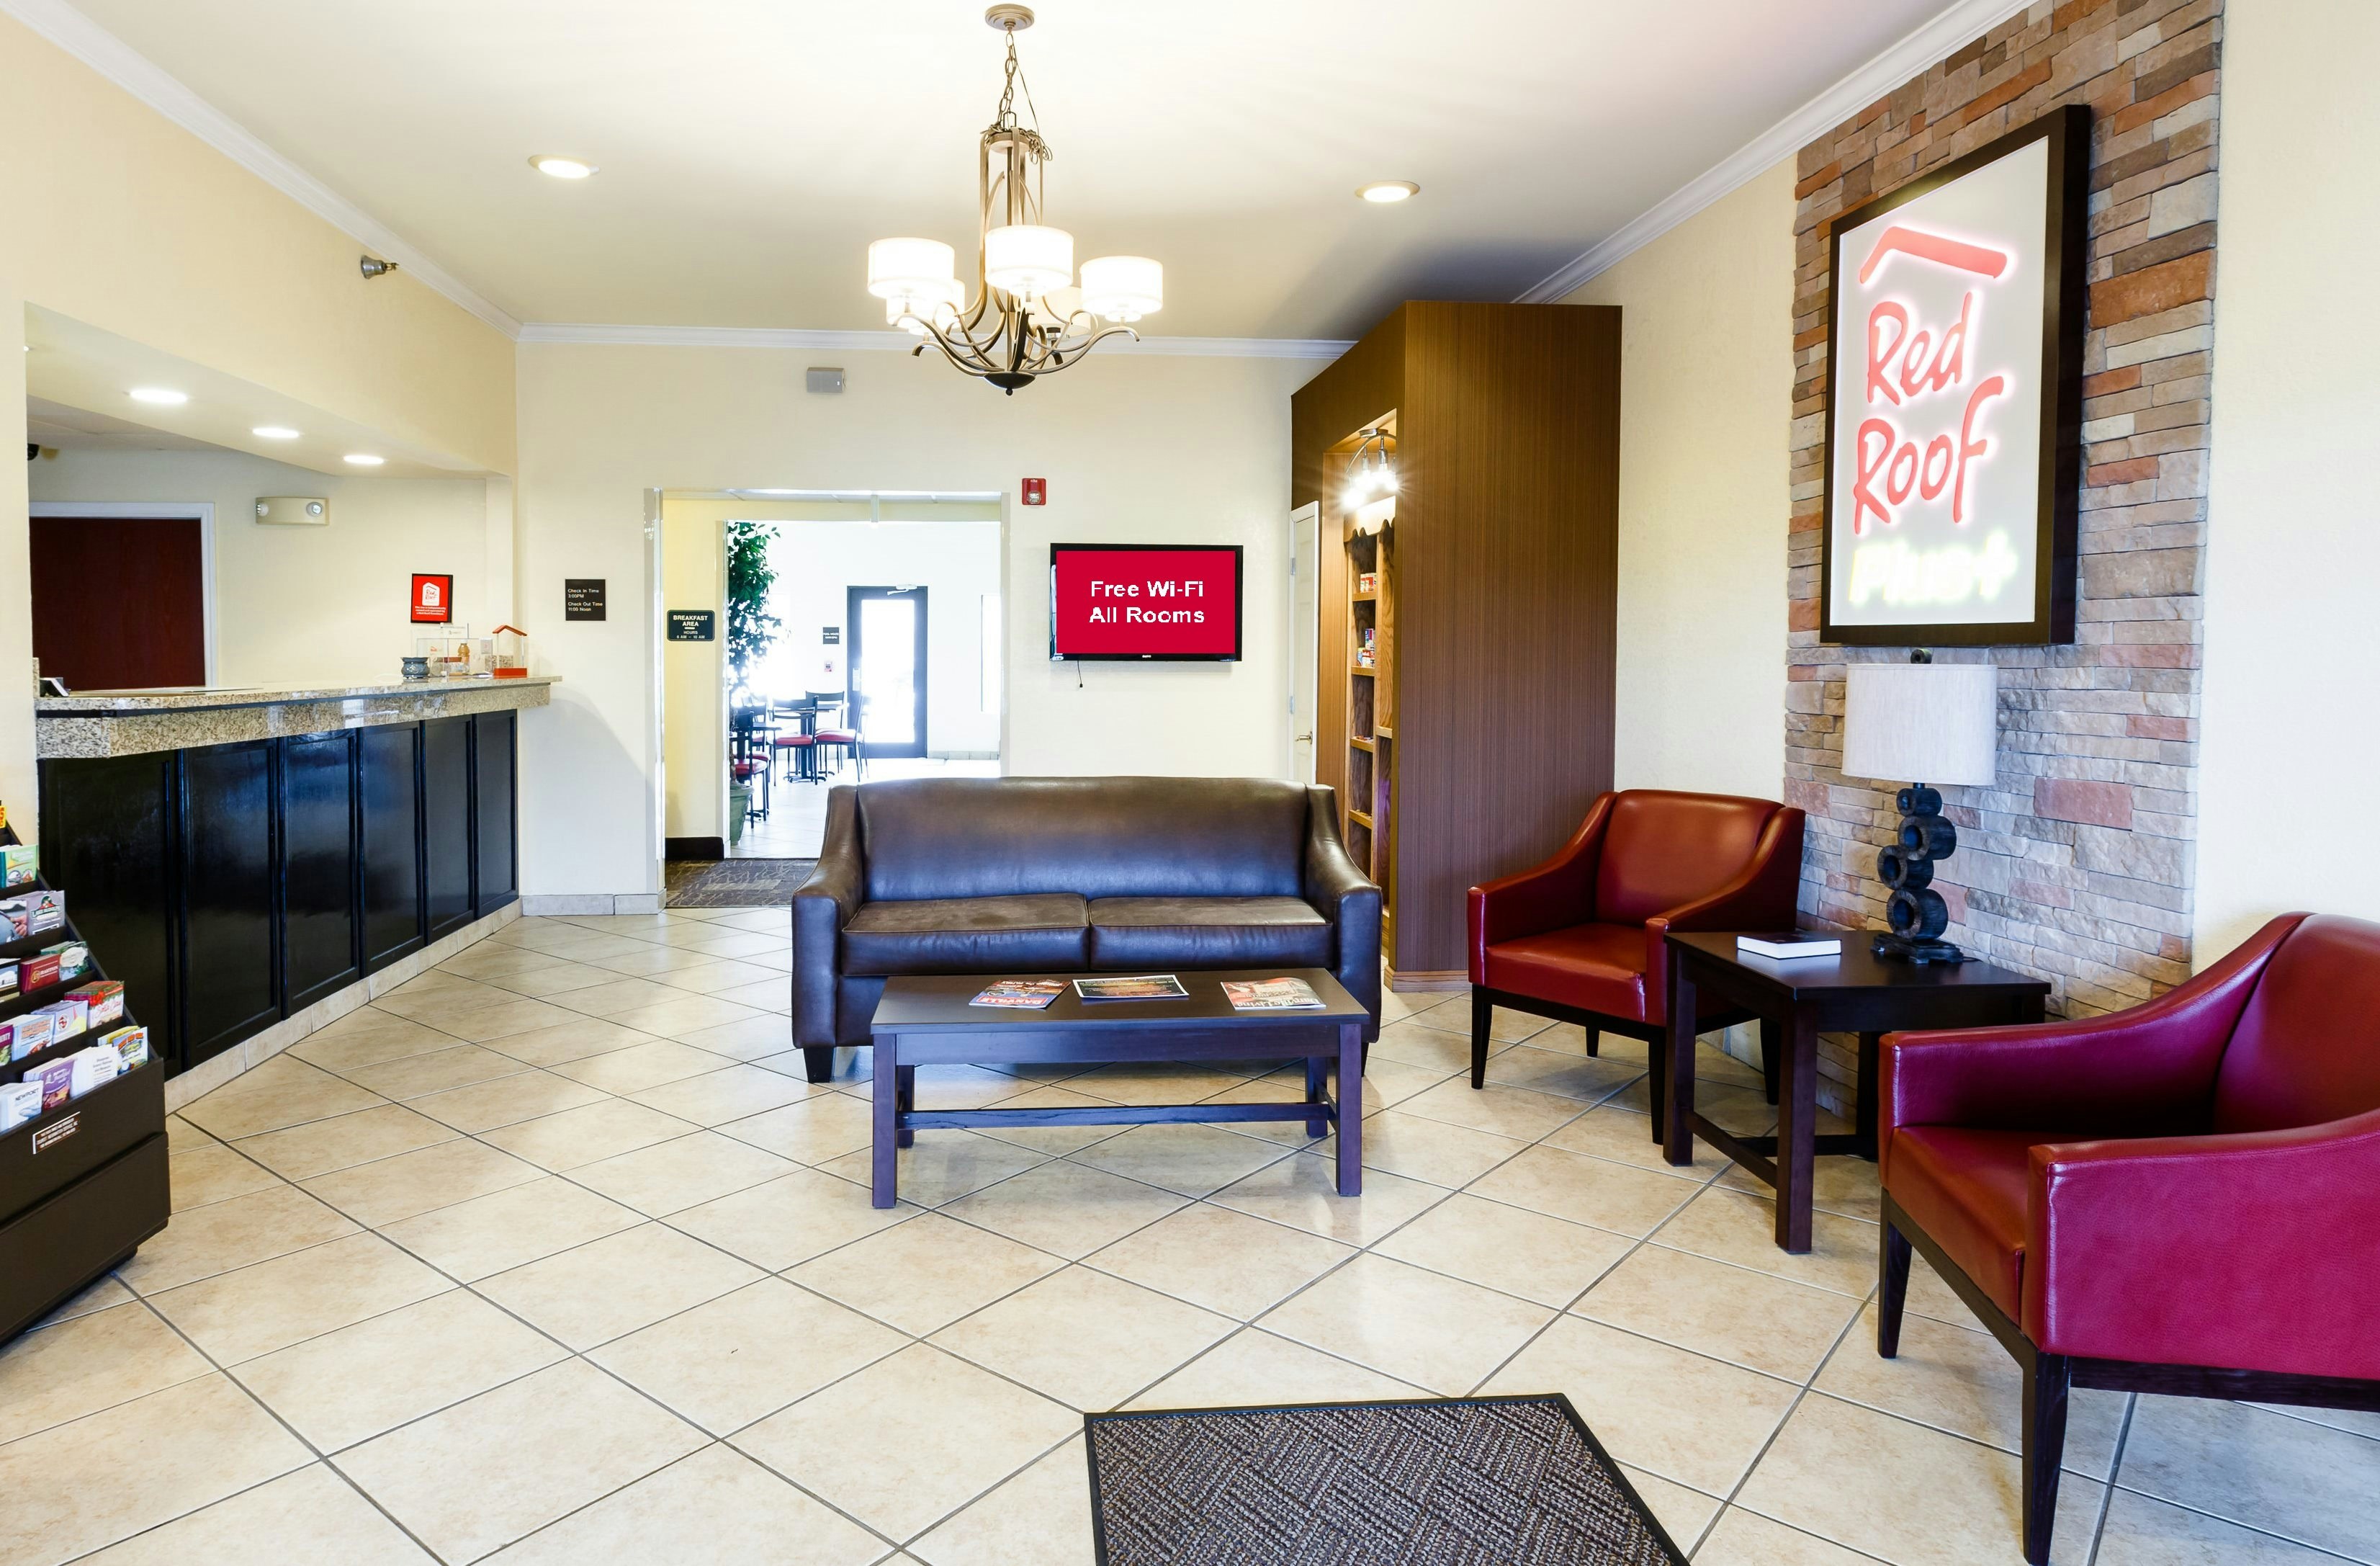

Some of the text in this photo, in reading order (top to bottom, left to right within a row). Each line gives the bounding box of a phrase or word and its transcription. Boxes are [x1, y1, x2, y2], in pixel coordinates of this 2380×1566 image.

[1867, 291, 1973, 406] Red
[1854, 375, 2005, 534] Roof
[1091, 581, 1203, 597] Free Wi-Fi
[1089, 607, 1205, 623] All Rooms
[981, 996, 1044, 1005] DANVILLE
[14, 1088, 40, 1101] NEWPORT
